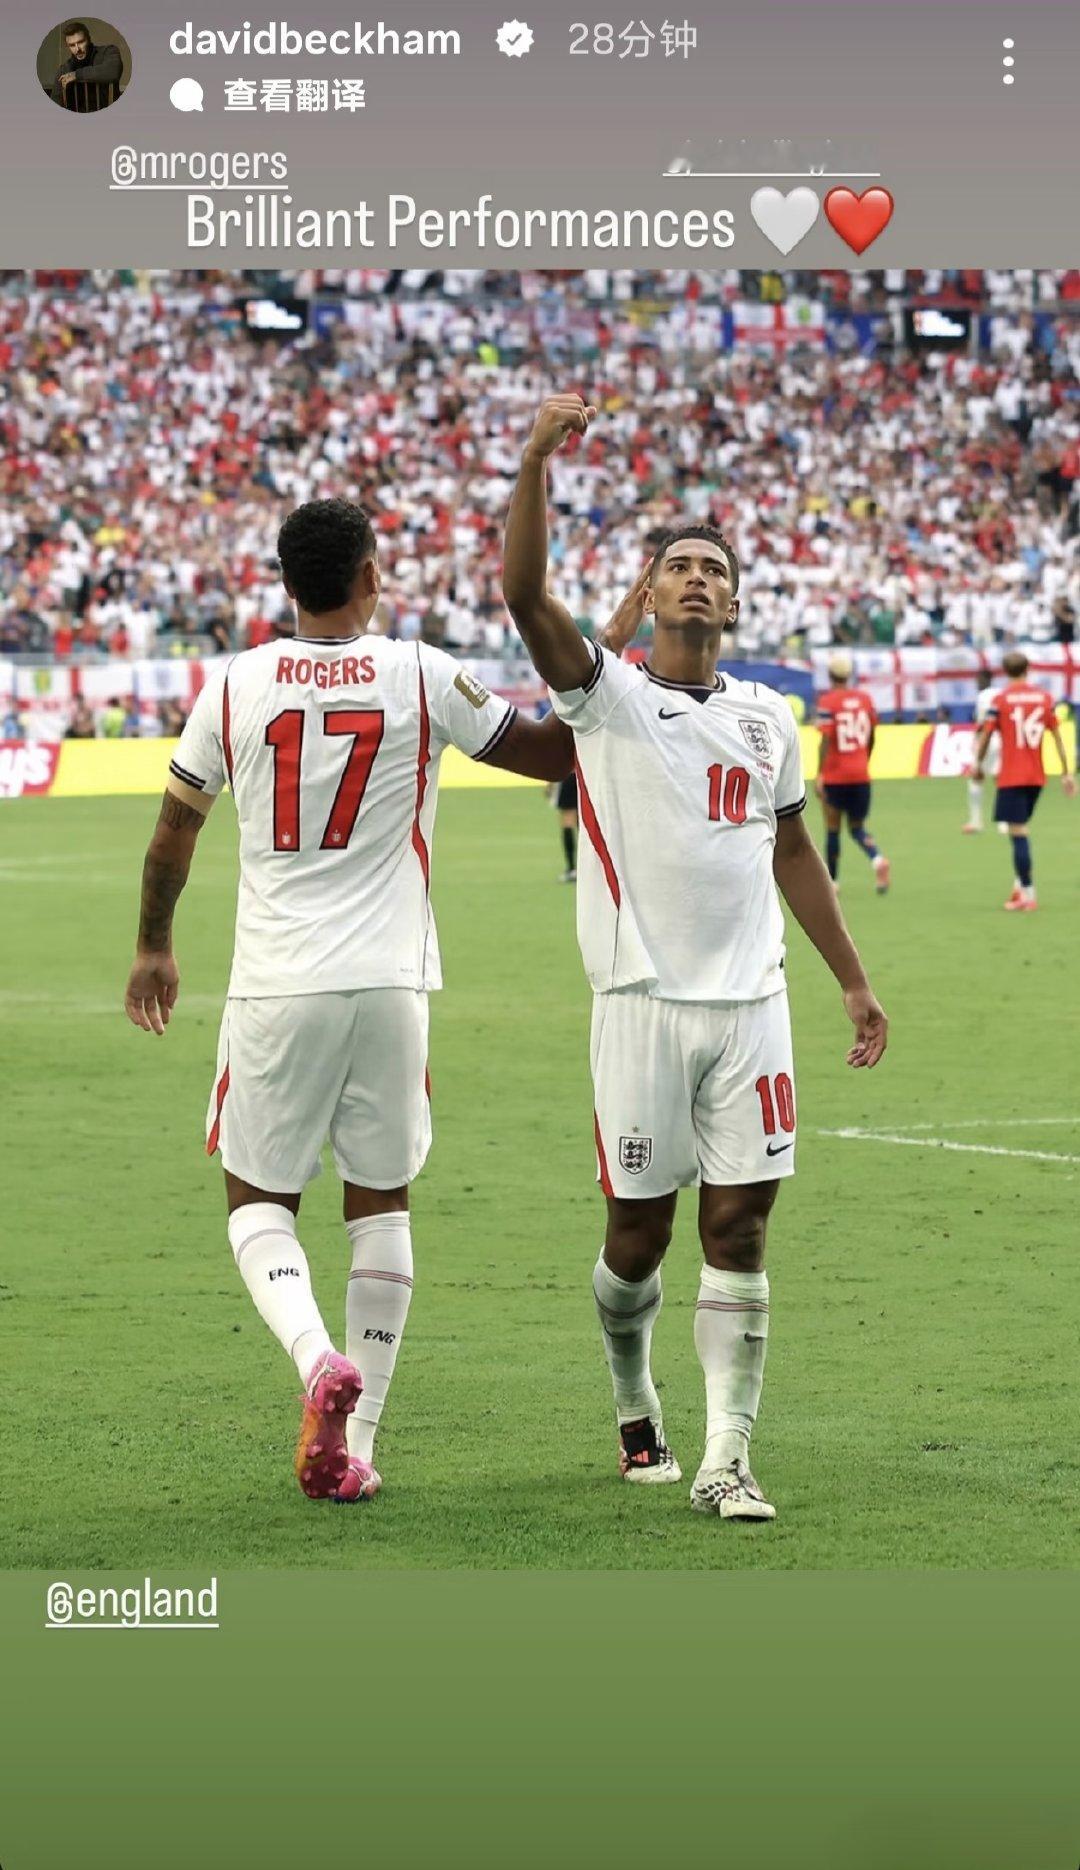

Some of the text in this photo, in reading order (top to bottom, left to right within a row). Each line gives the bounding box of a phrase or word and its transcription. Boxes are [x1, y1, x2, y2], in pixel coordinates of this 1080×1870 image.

[276, 655, 376, 690] ROGERS
[1008, 705, 1045, 750] 16
[265, 709, 385, 852] 17
[706, 762, 751, 825] 10
[755, 1072, 796, 1136] 10
[268, 1266, 301, 1282] ENG
[363, 1328, 396, 1346] ENG
